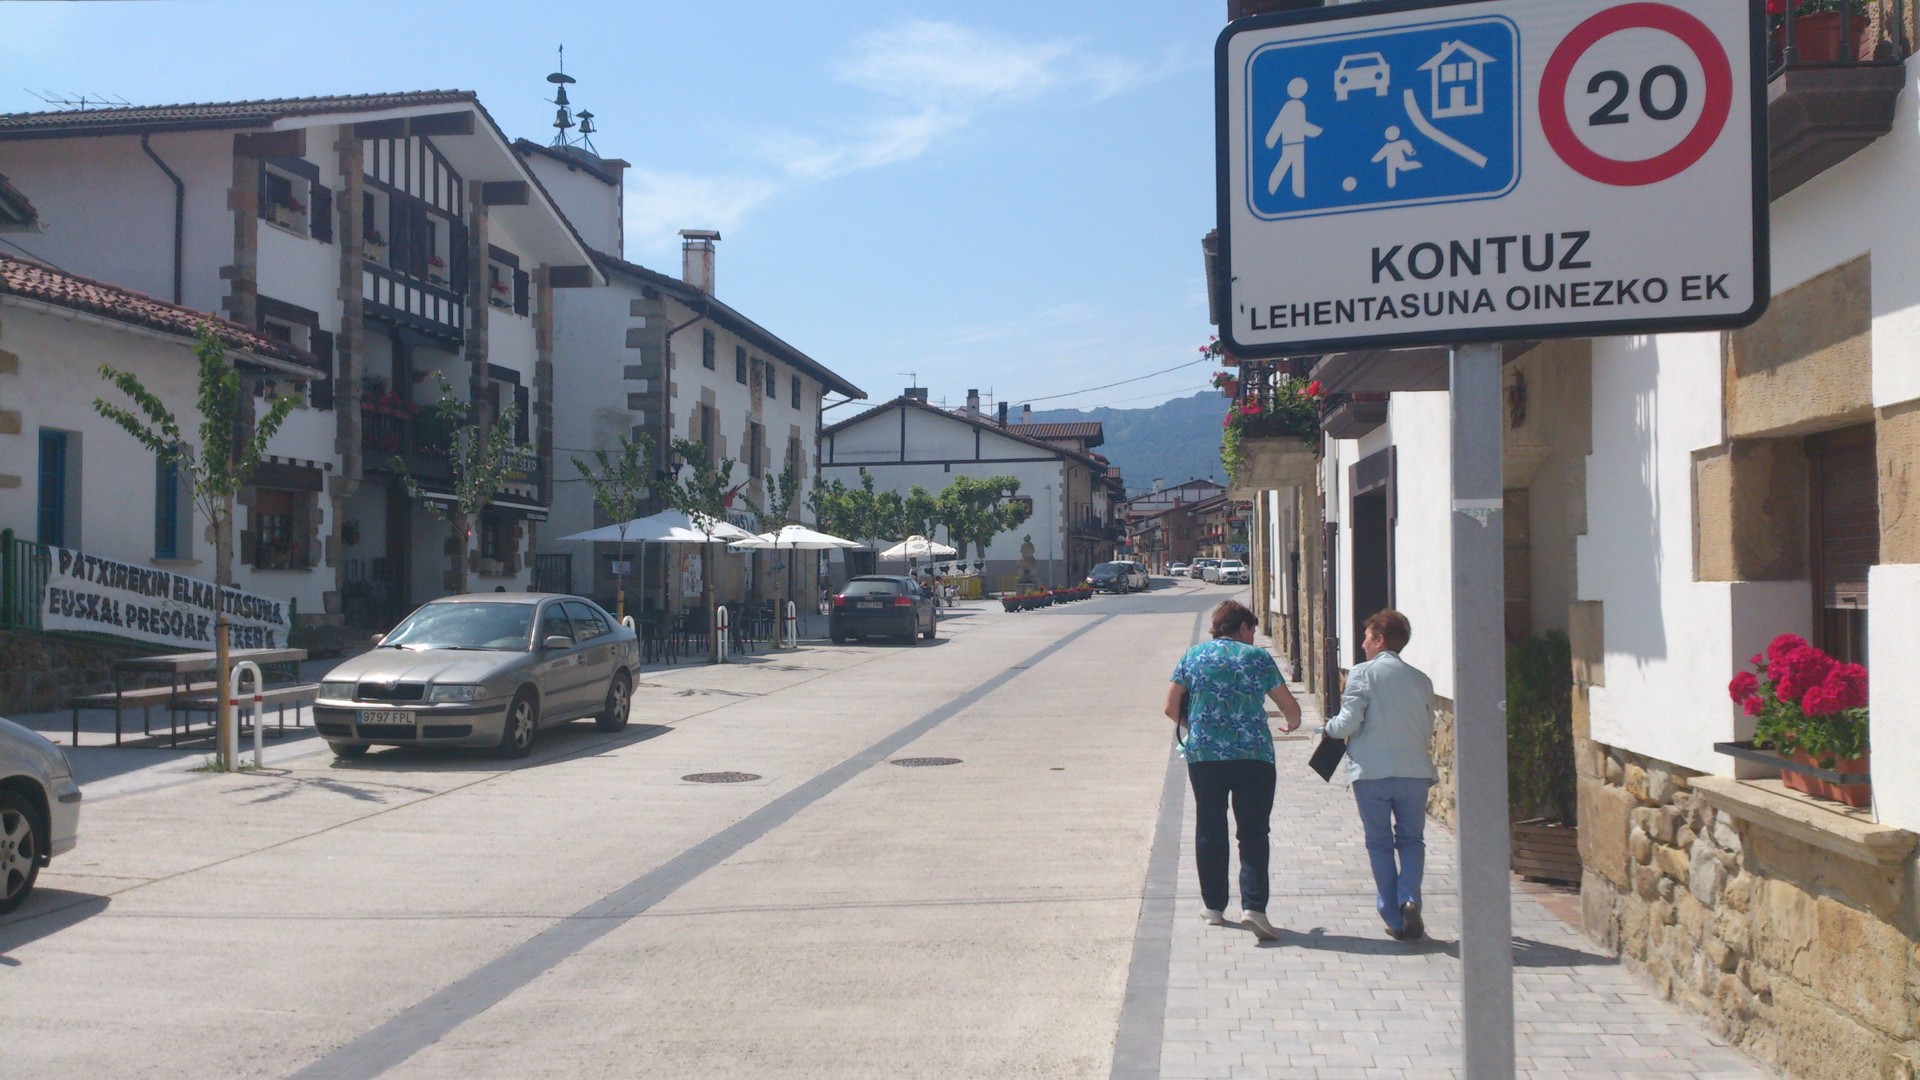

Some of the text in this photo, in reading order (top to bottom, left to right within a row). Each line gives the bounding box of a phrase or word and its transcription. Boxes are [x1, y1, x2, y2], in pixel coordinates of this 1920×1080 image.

[1587, 64, 1688, 126] 20
[1371, 230, 1592, 284] KONTUZ
[1250, 273, 1731, 331] LEHENTASUNA OINEZKO EK
[58, 548, 171, 599] PATXIREKIN
[49, 587, 124, 627] EUSKAL
[125, 603, 211, 642] PRESOAK
[362, 711, 413, 724] 9797 FPL
